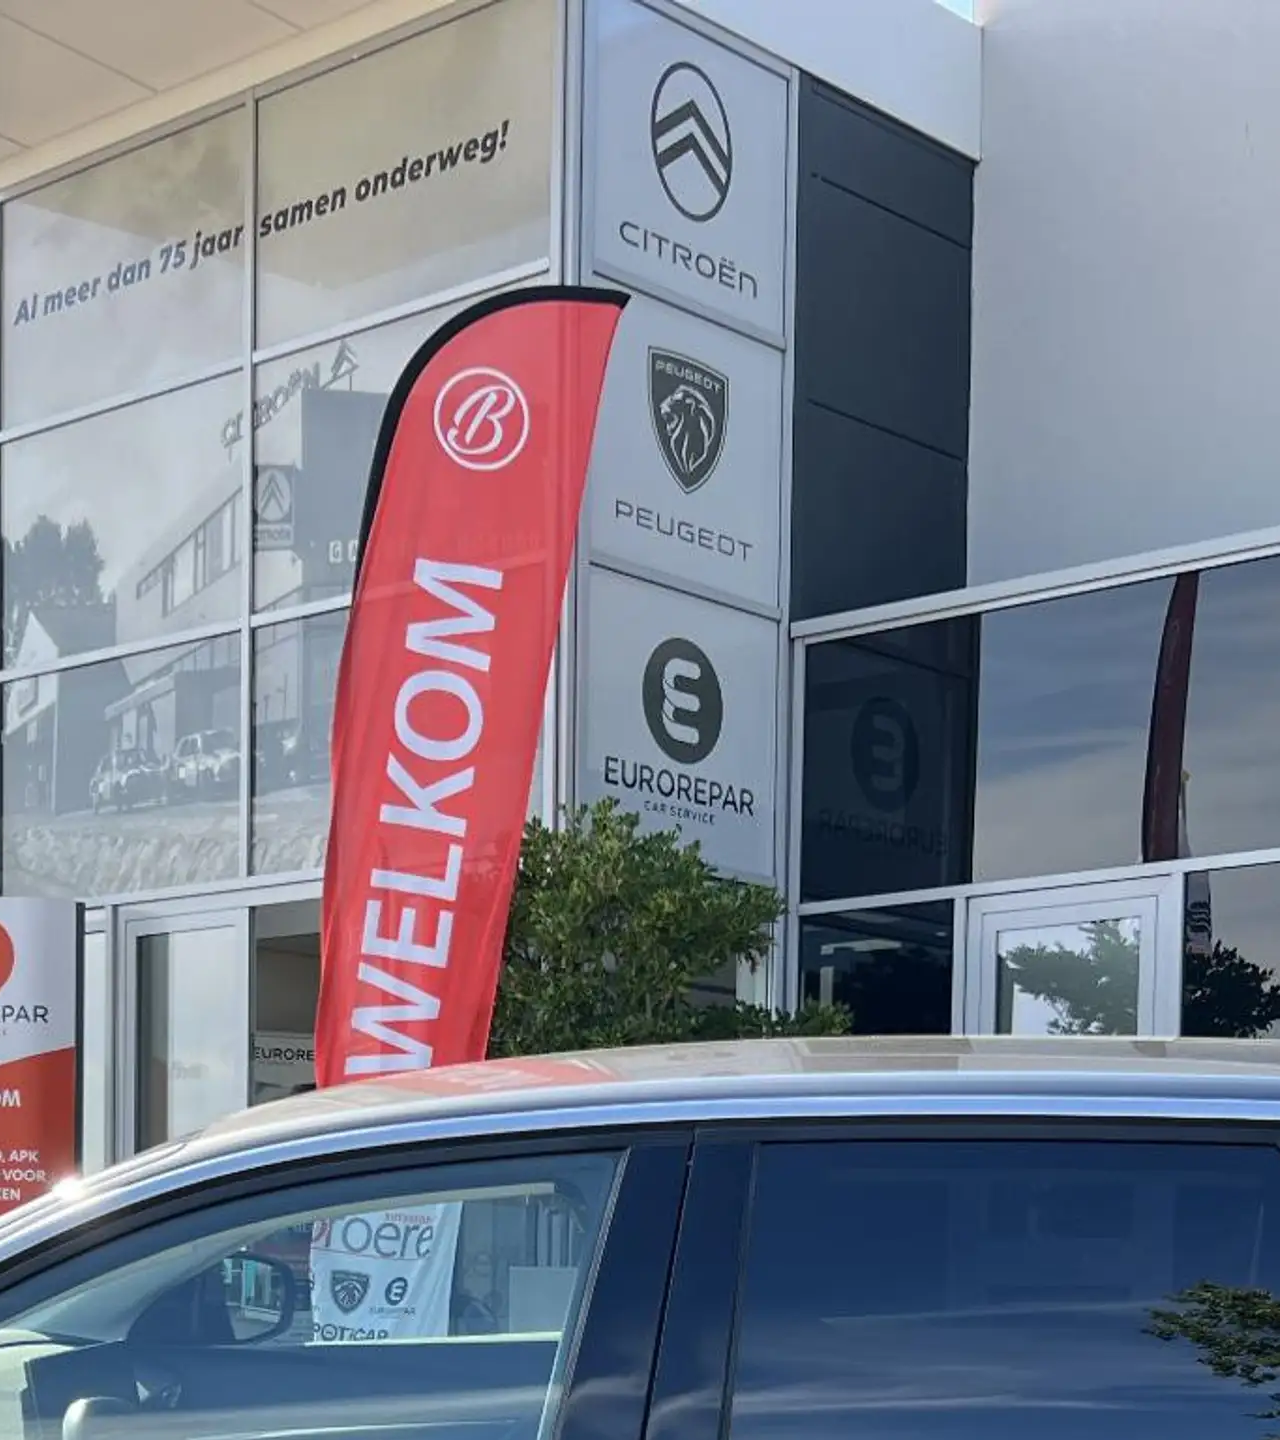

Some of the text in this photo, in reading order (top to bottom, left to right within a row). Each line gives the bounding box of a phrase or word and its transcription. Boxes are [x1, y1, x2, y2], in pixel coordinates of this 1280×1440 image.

[13, 119, 510, 327] Al meer dan 75 jaar samen onderweg!
[619, 219, 759, 300] CITROËN
[654, 359, 723, 394] PEUGEOT
[615, 498, 754, 563] PEUGEOT
[604, 755, 755, 817] EUROREPAR
[344, 556, 504, 1077] WELKOM
[643, 800, 716, 826] CAR SERVICE
[254, 1047, 316, 1062] EURORE
[2, 1168, 47, 1182] VOOR
[9, 1149, 39, 1162] APK
